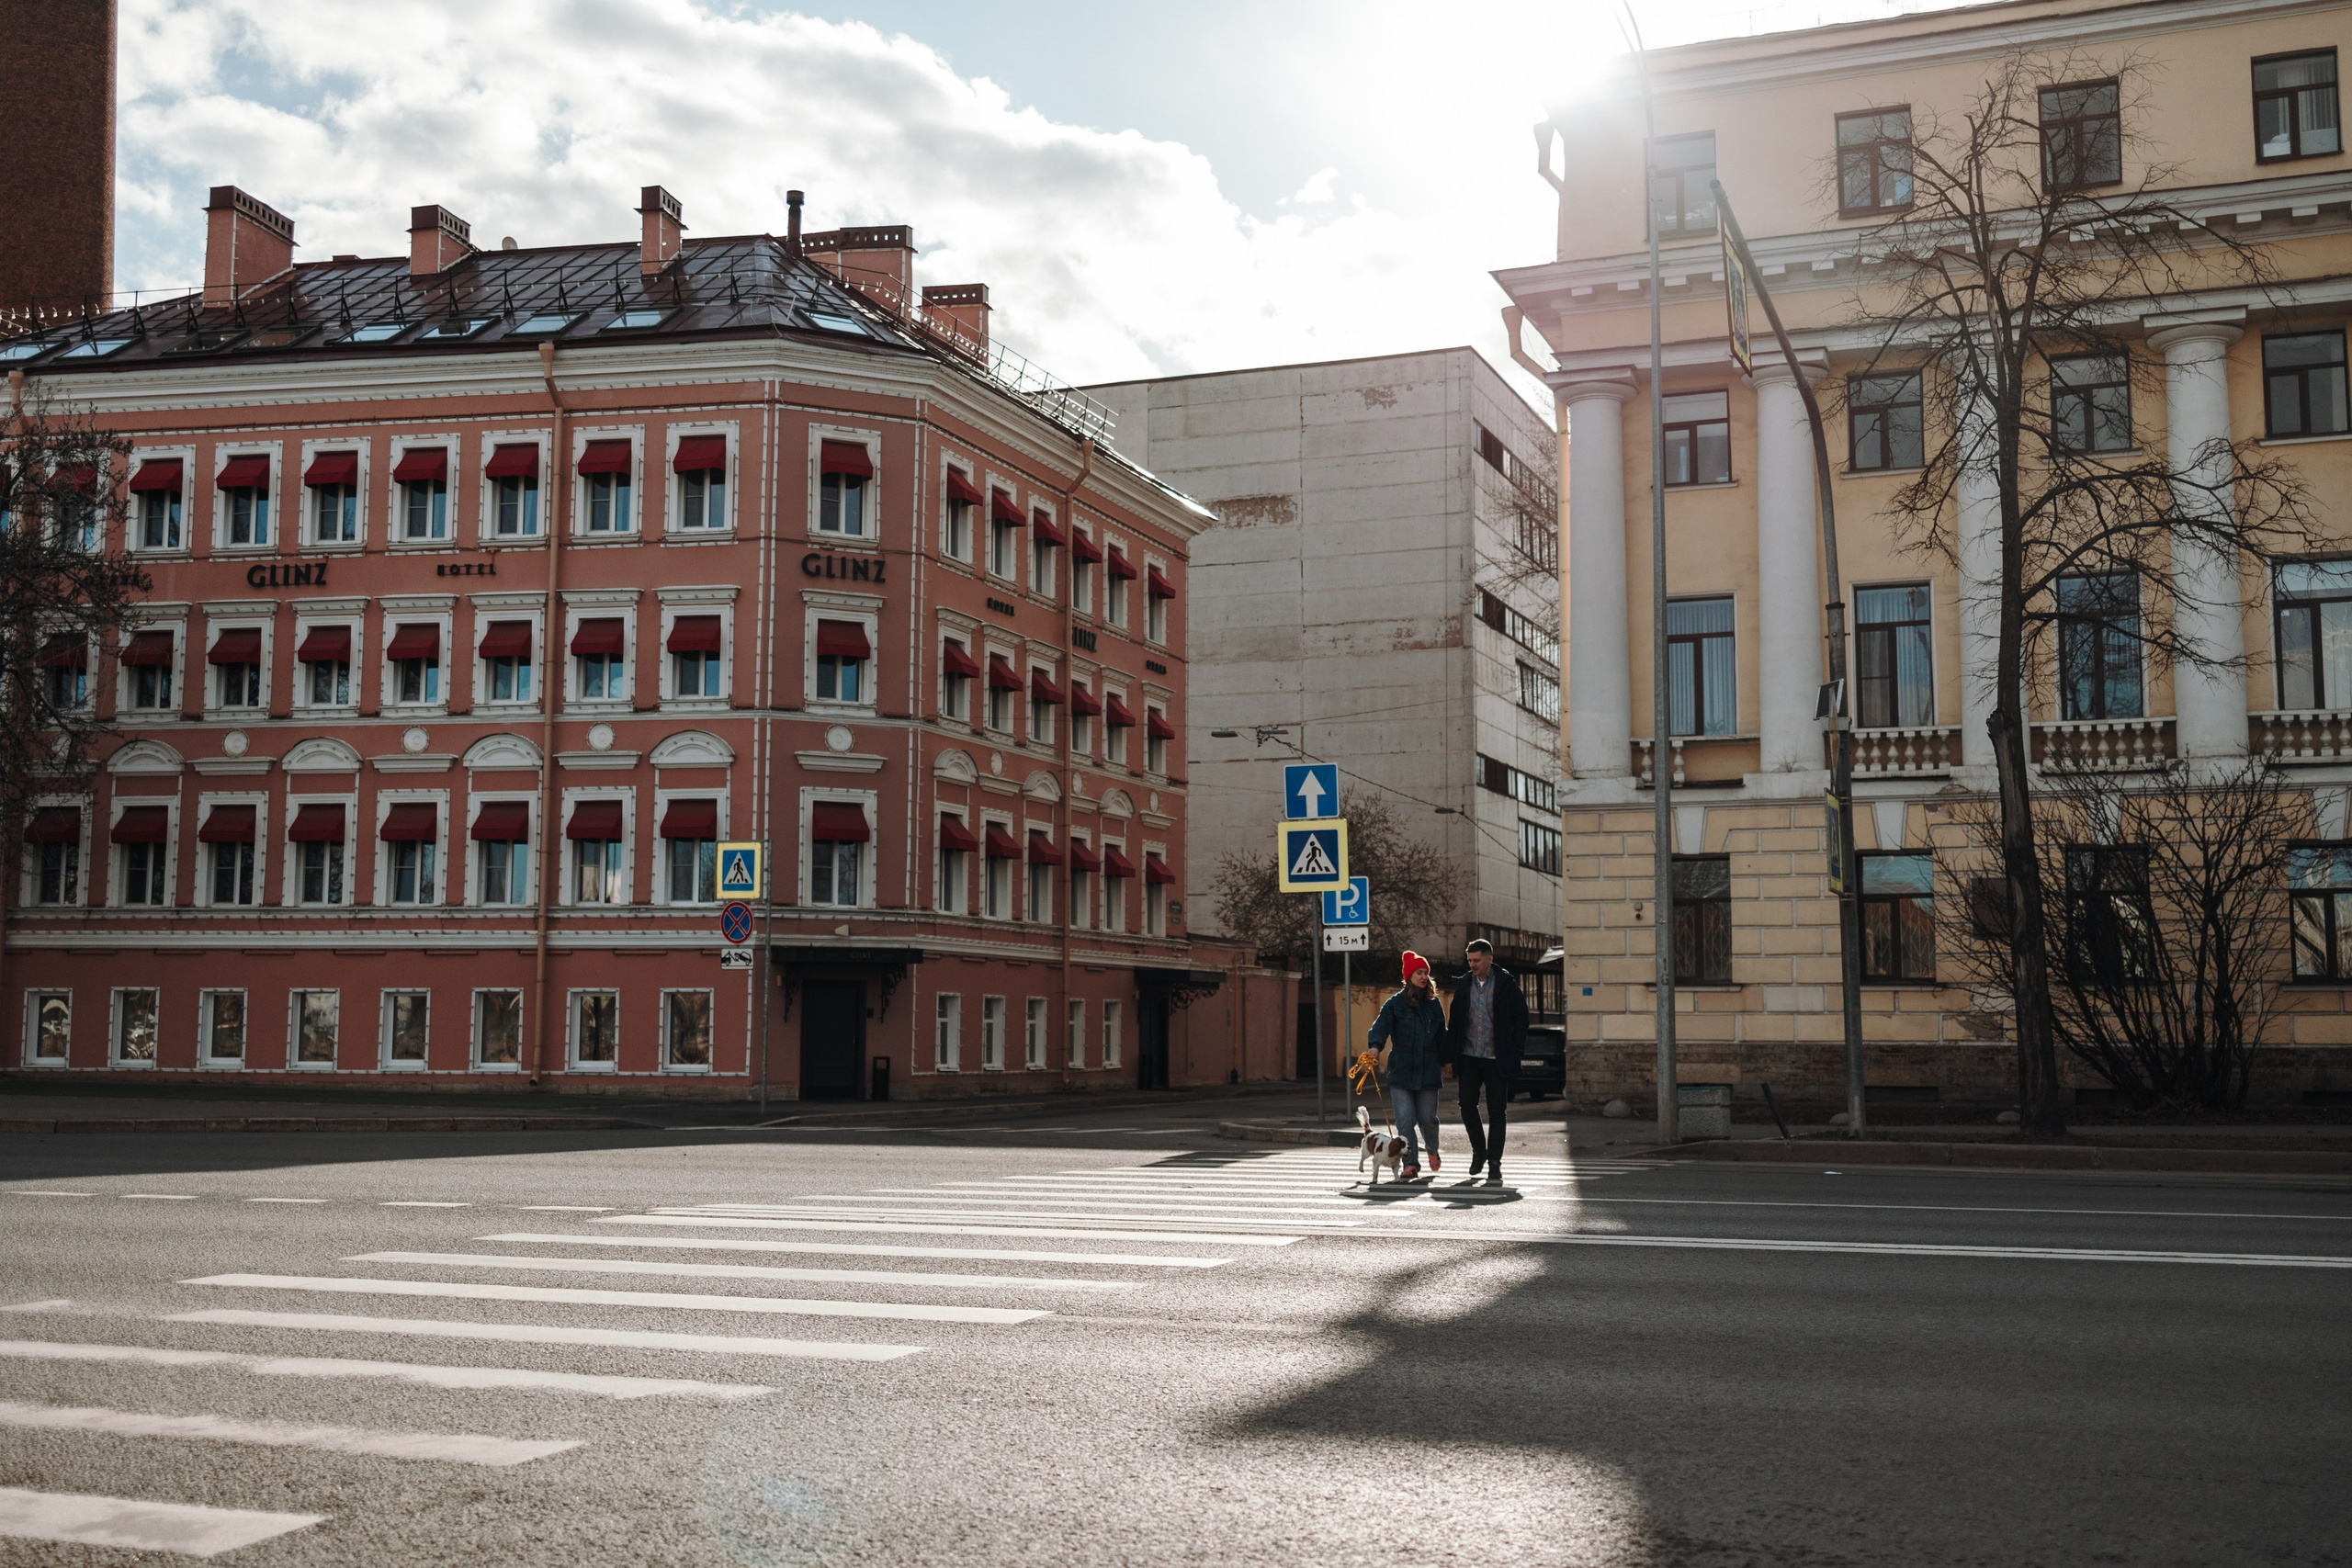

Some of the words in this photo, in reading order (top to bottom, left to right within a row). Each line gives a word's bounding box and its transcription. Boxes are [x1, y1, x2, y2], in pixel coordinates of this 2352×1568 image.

[247, 562, 327, 588] GLINZ
[436, 563, 496, 577] HOTEL
[801, 553, 886, 582] GLINZ
[1336, 883, 1360, 919] P
[1339, 935, 1350, 945] 15
